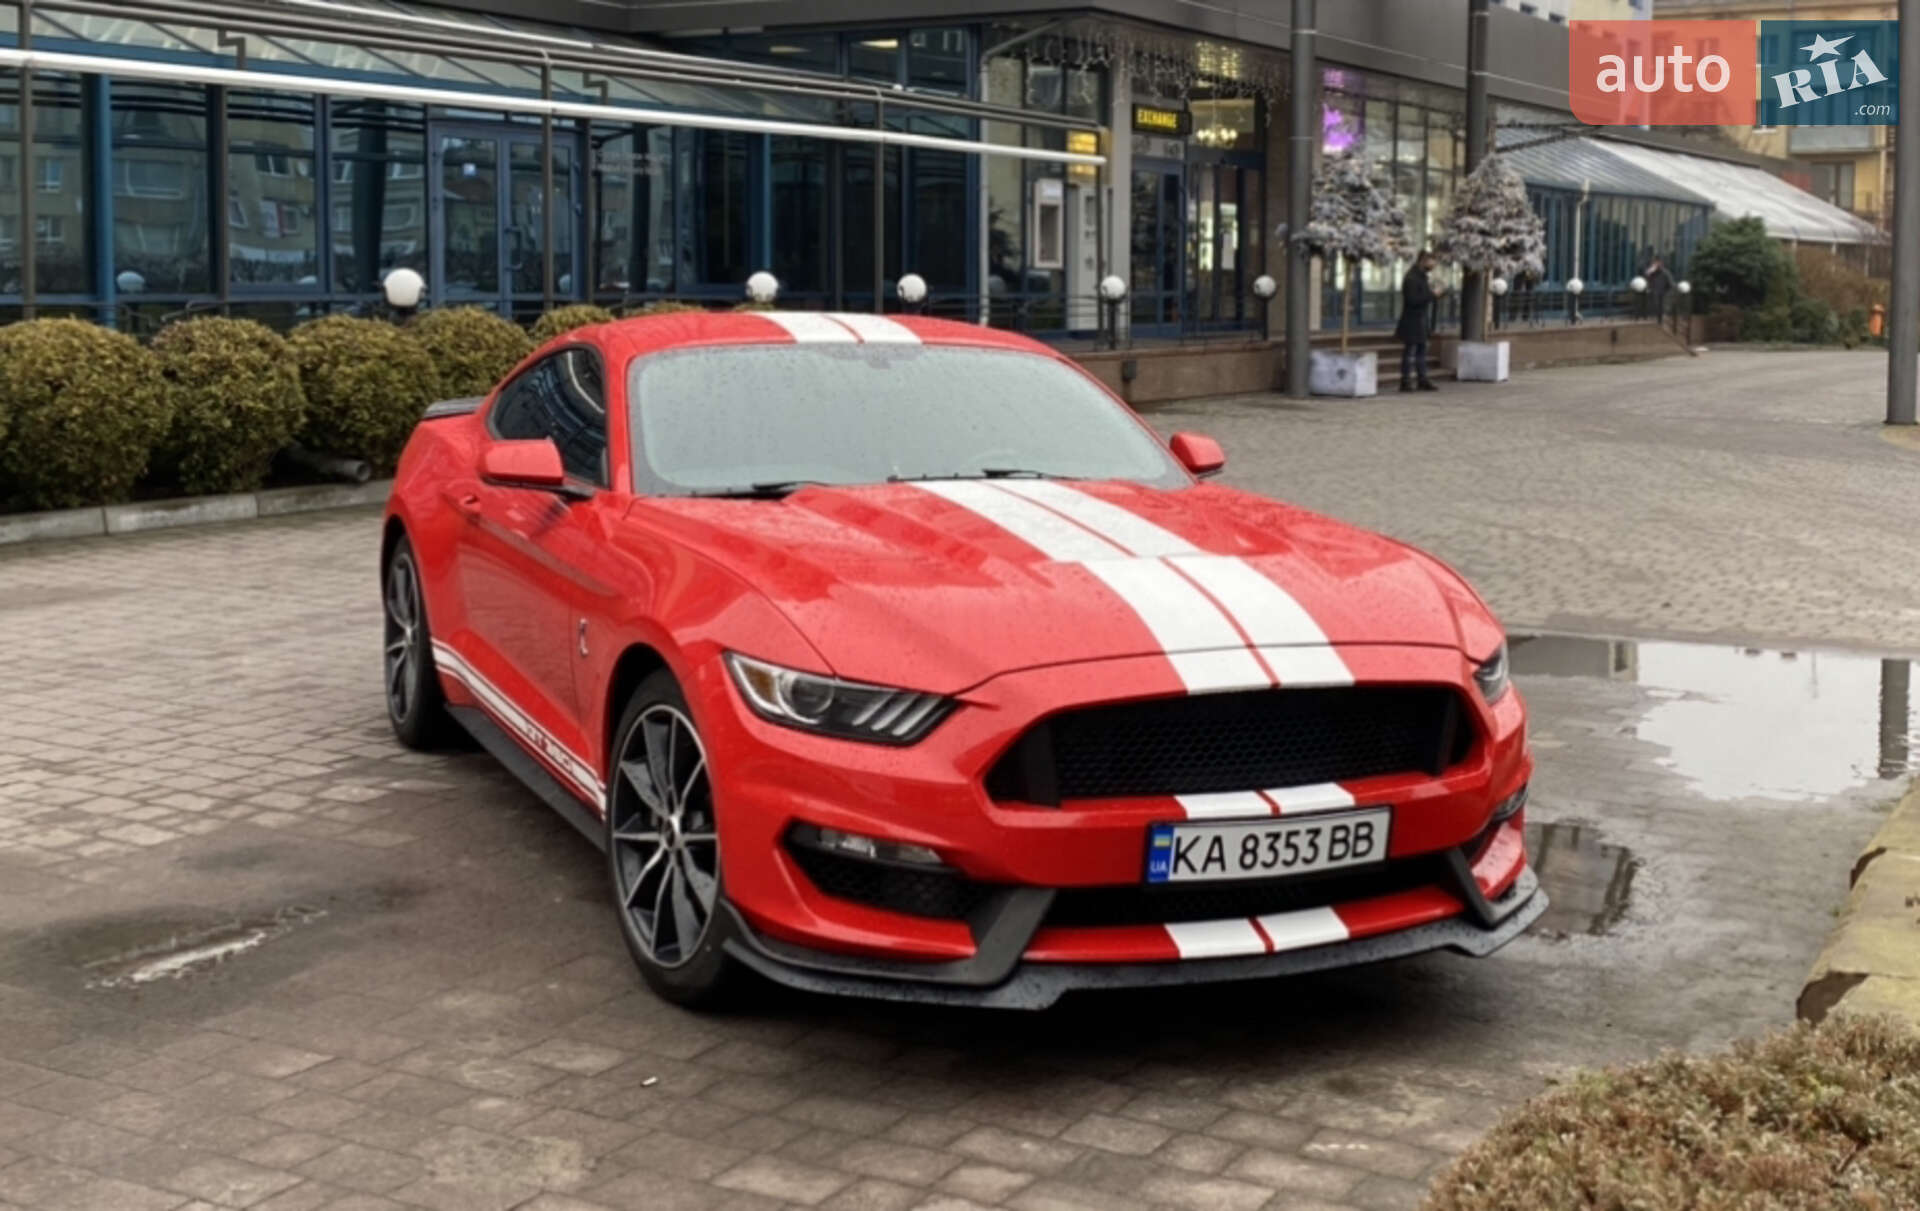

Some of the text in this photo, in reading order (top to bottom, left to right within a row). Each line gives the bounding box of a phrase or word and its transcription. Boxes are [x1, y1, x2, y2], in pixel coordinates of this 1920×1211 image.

[1137, 108, 1178, 128] EXCHANGE
[1172, 821, 1375, 874] KA 8353 BB
[1150, 860, 1168, 873] UA
